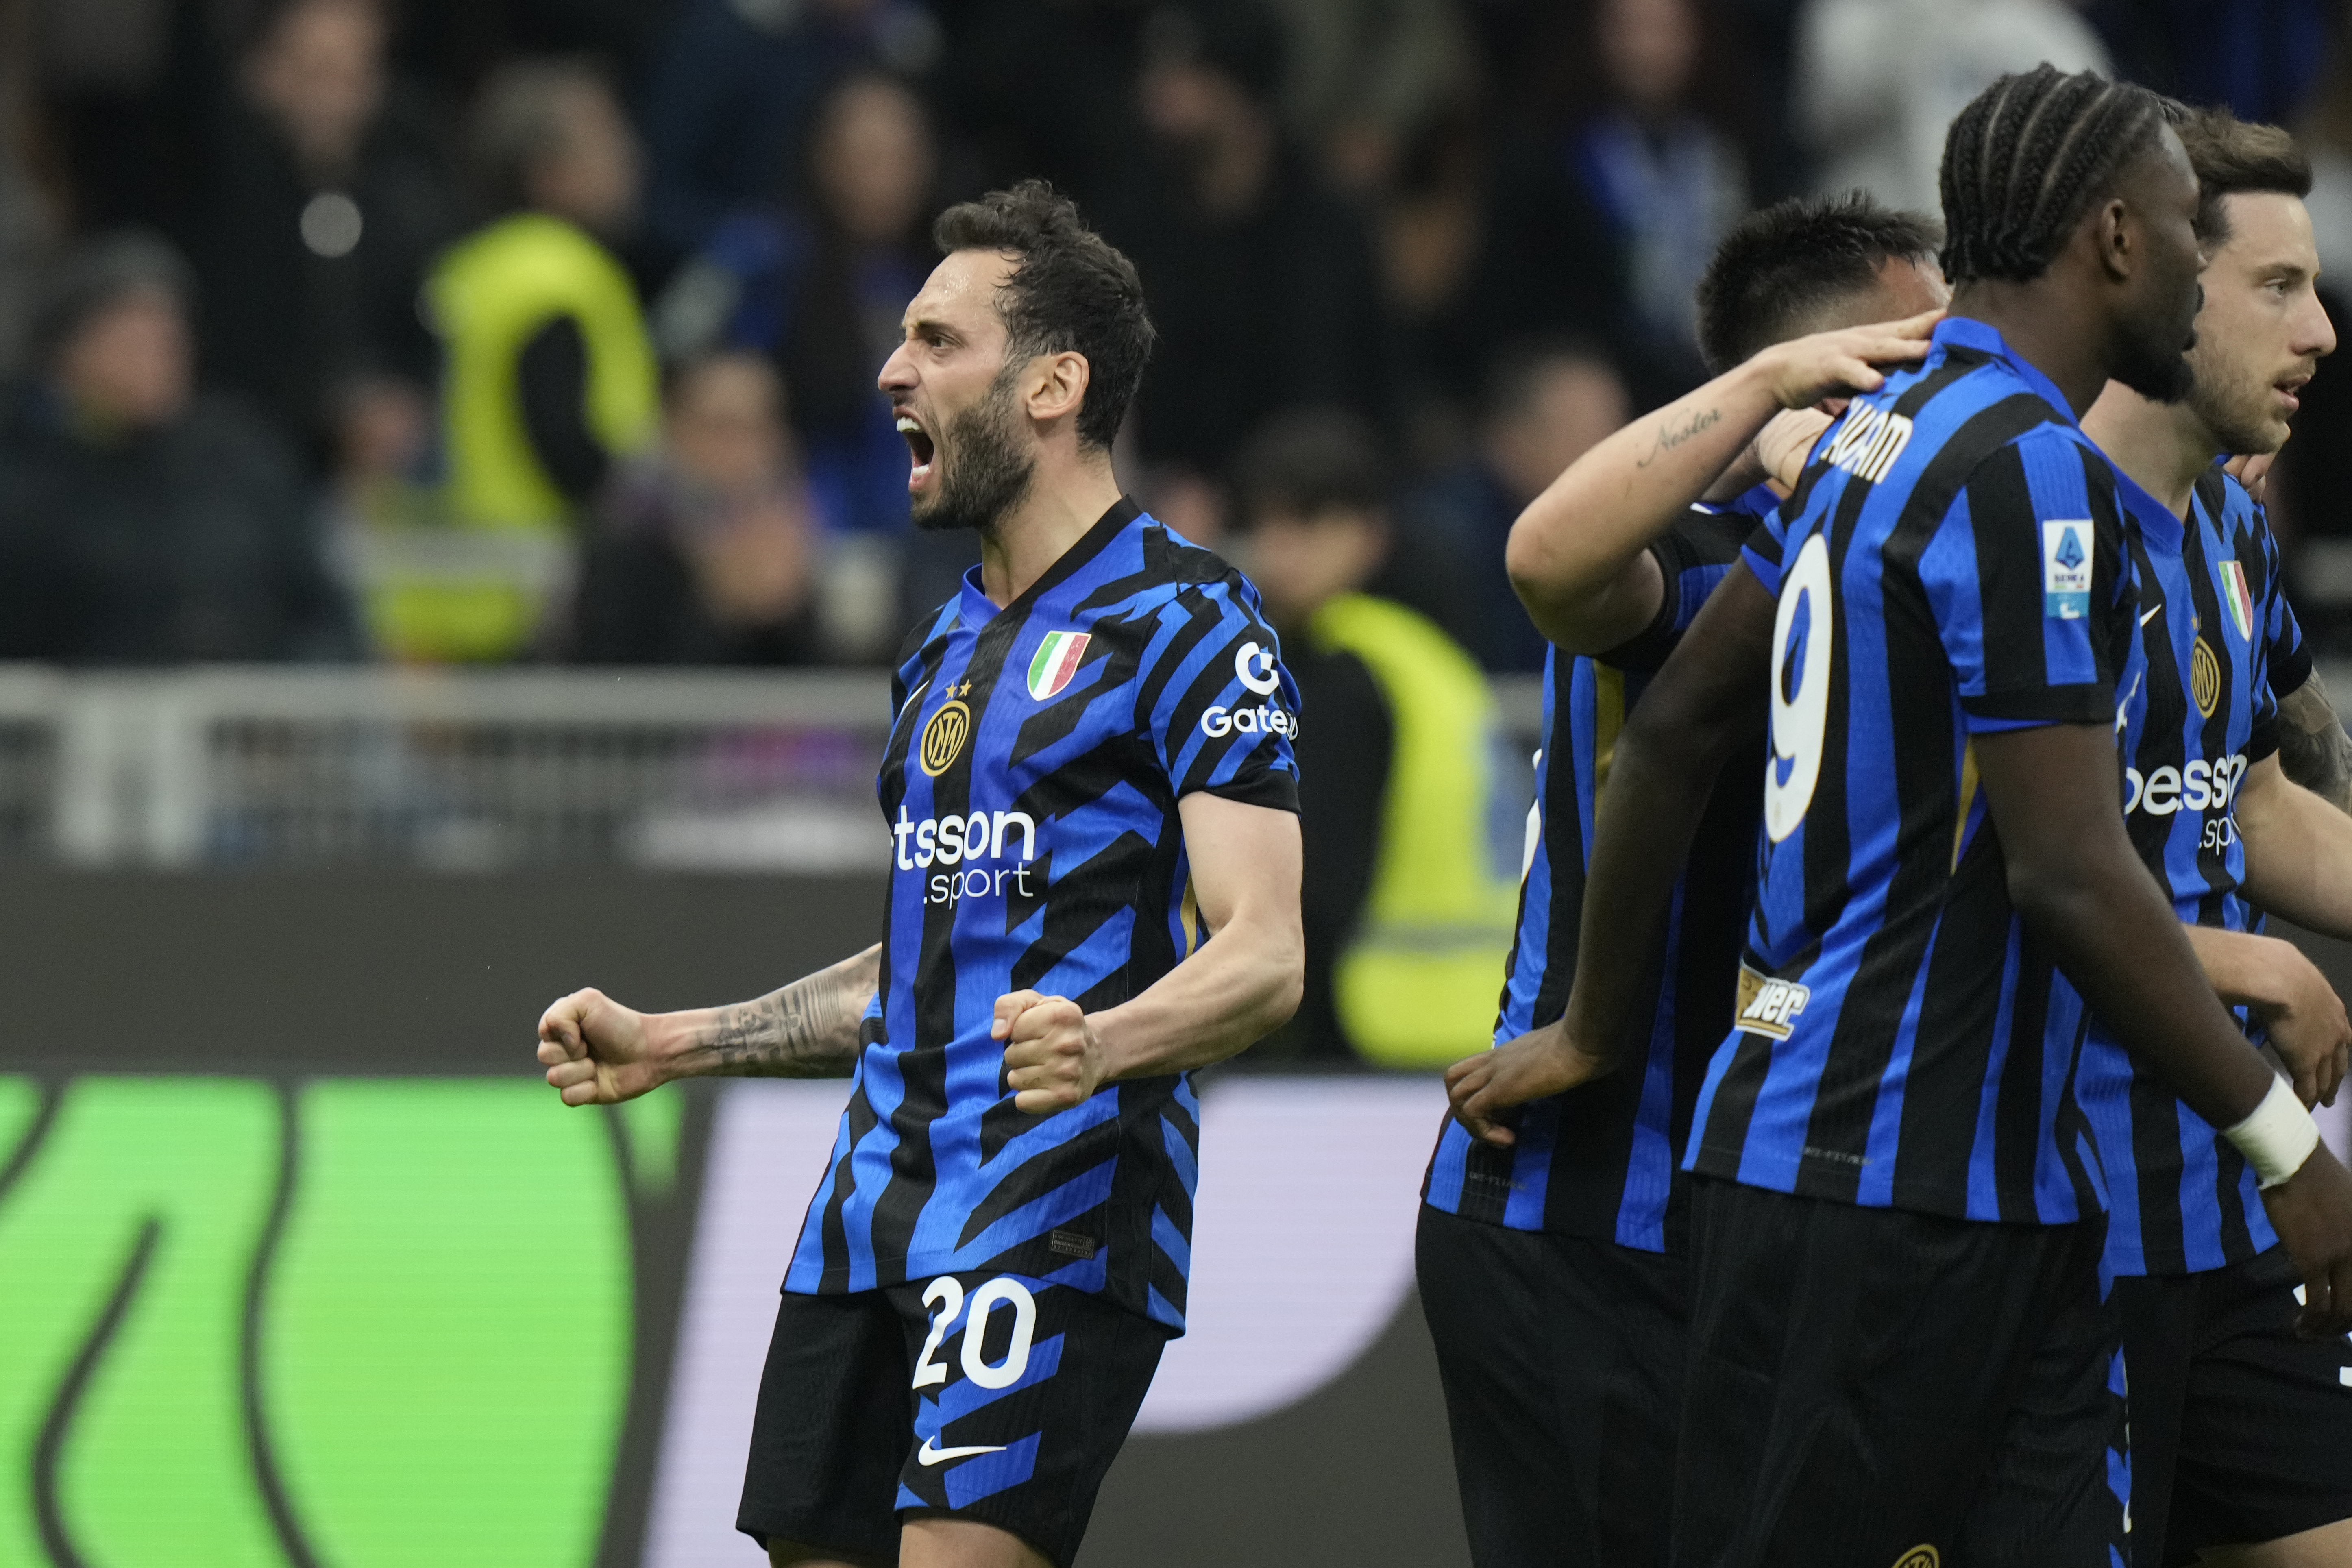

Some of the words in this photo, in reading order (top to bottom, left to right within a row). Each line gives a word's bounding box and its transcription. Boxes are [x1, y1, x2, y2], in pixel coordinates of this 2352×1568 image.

[1764, 533, 1833, 843] 9
[891, 805, 1035, 871] tsson
[923, 862, 1034, 910] .sport
[912, 1276, 1036, 1390] 20
